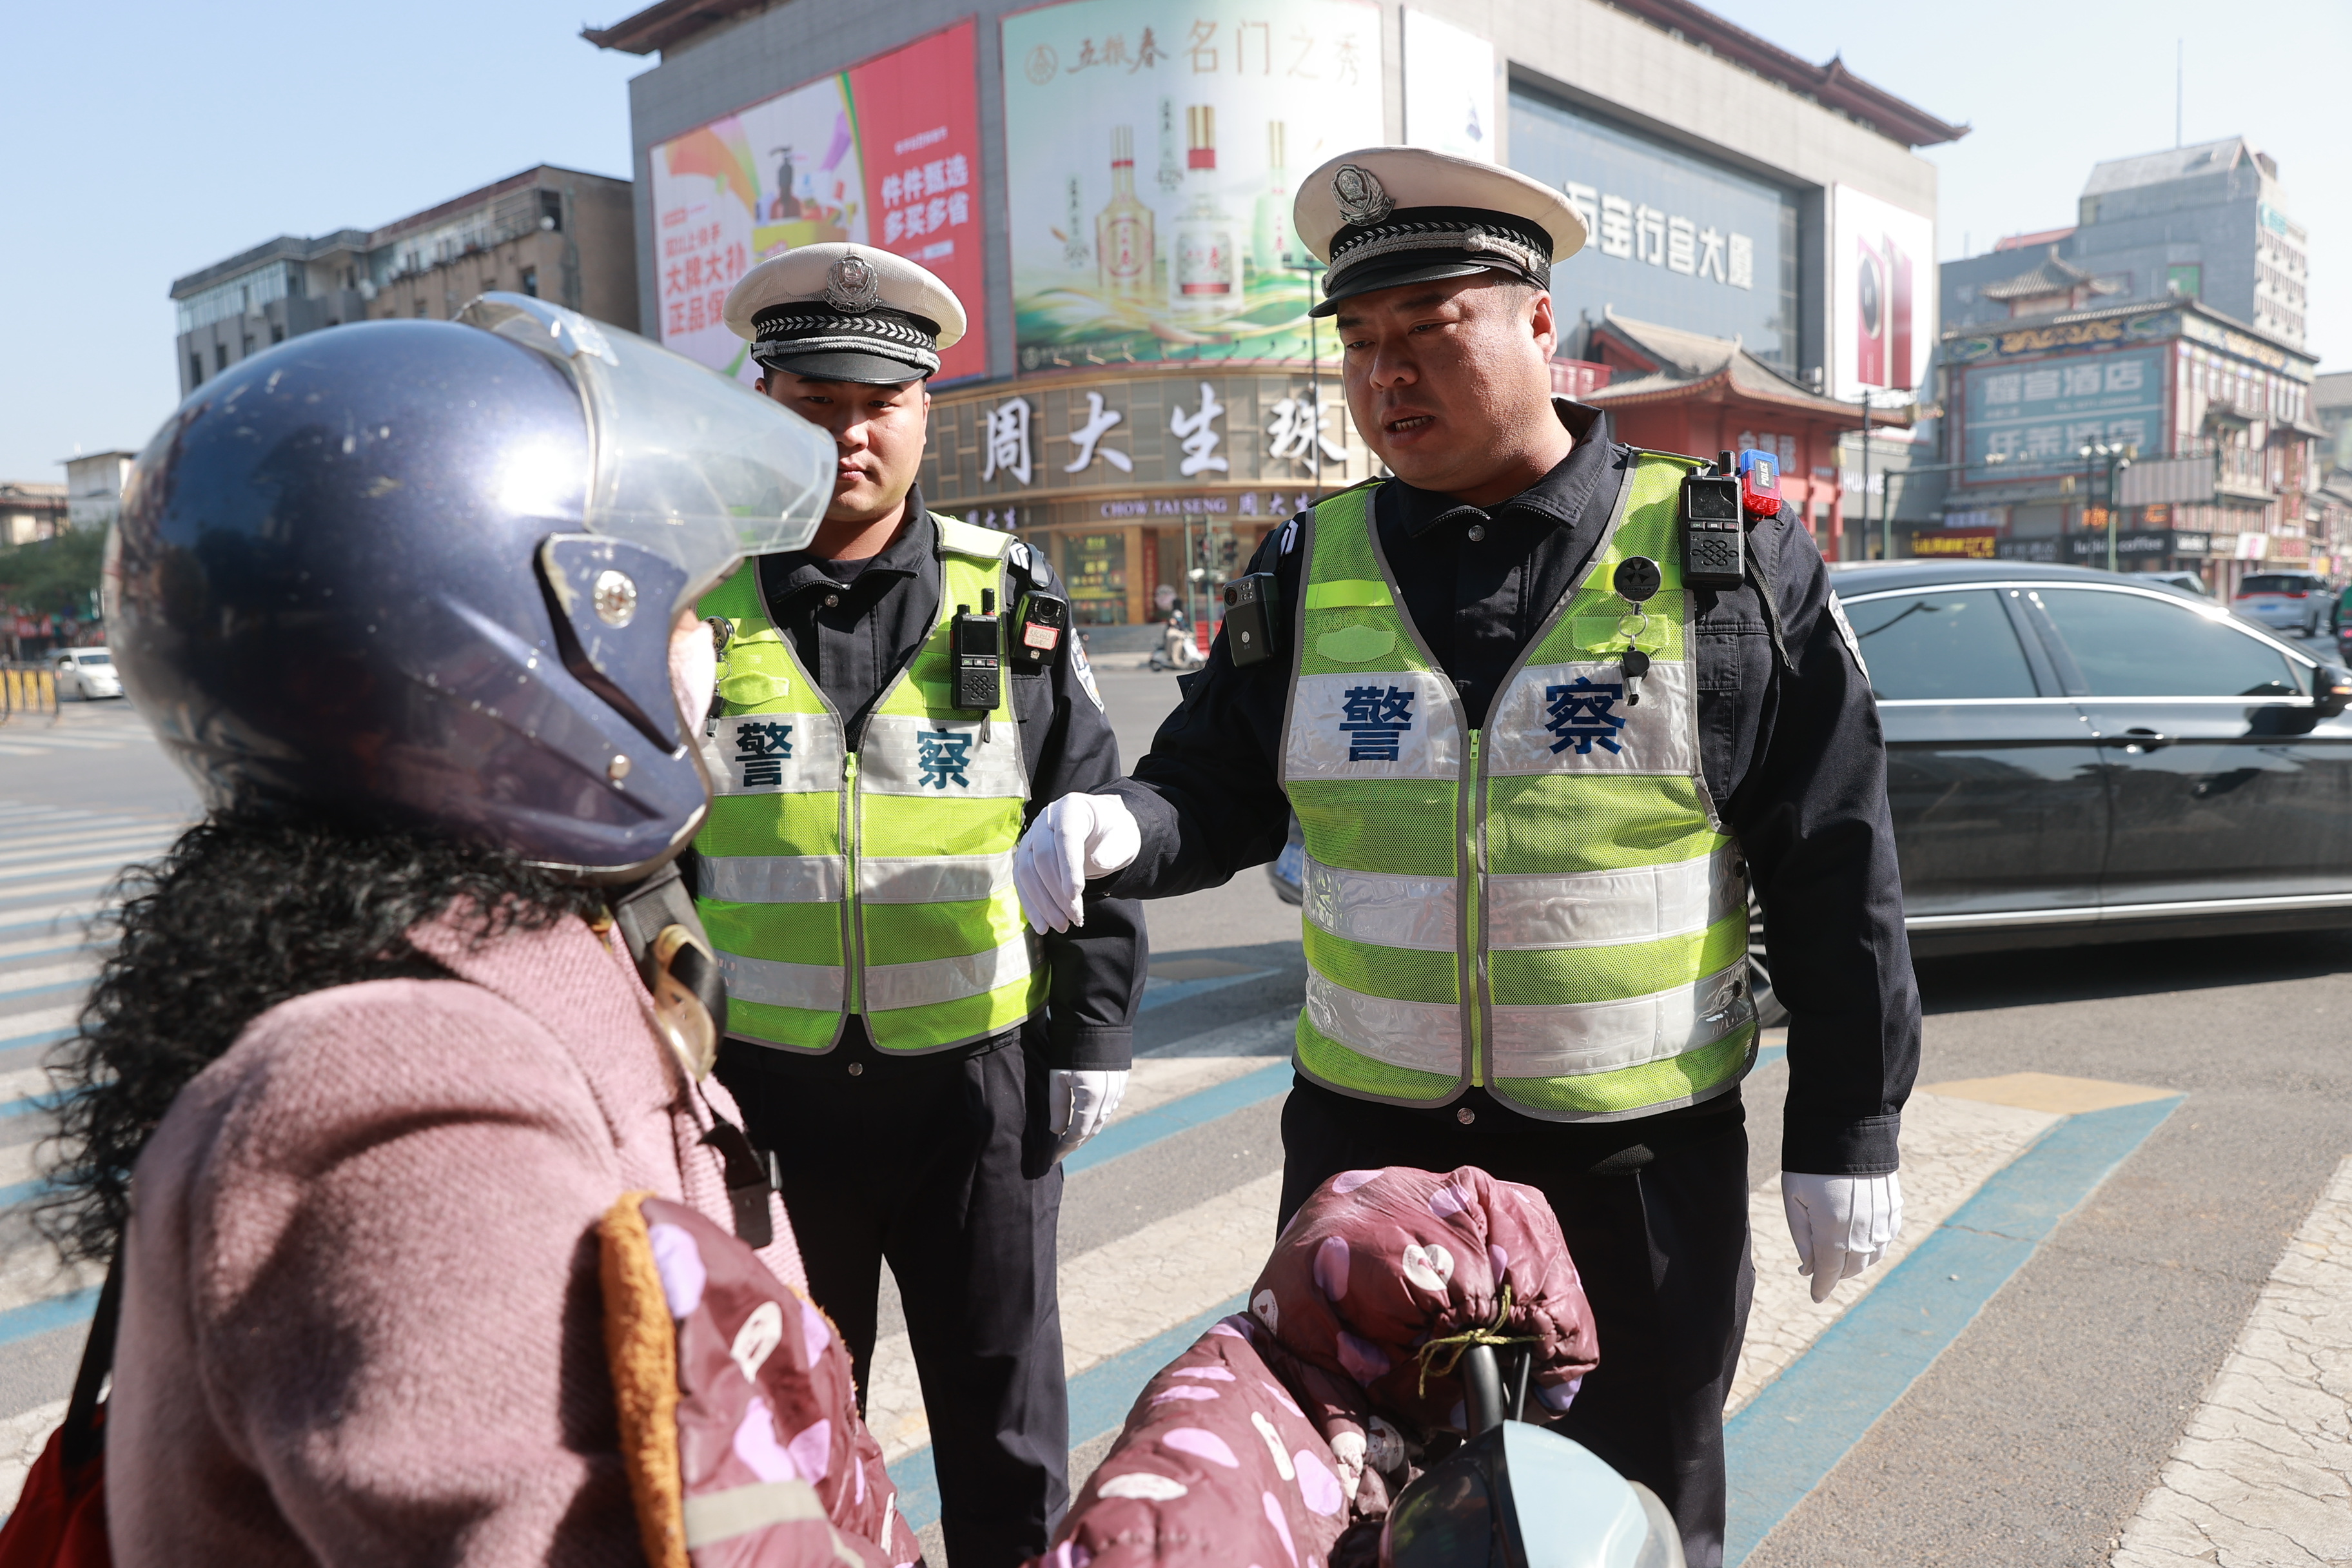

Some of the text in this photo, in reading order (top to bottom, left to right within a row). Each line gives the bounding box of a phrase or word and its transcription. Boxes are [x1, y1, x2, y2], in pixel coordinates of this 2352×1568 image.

[1184, 17, 1359, 86] 名门之秀
[883, 190, 970, 246] 多买多省
[667, 286, 736, 337] 正品保
[983, 381, 1349, 486] 周大生珠
[1759, 460, 1770, 487] POLICE
[1101, 500, 1149, 517] CHOW
[1182, 498, 1228, 515] SENG
[1338, 676, 1626, 762] 警 察
[734, 721, 973, 789] 警 察
